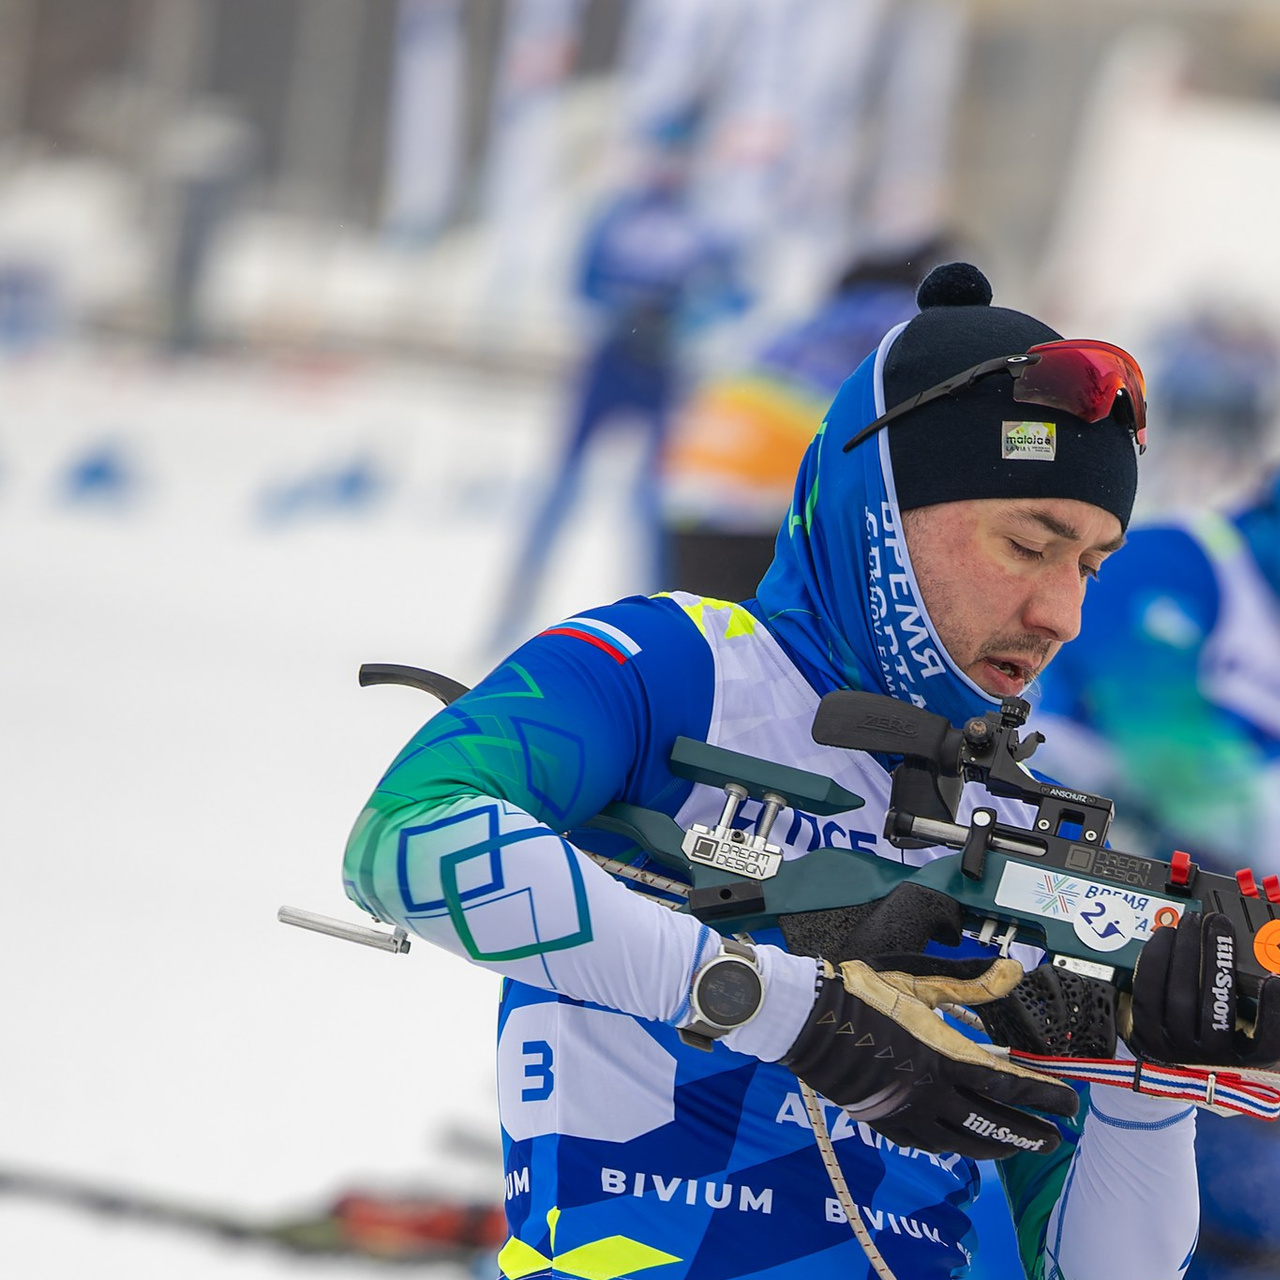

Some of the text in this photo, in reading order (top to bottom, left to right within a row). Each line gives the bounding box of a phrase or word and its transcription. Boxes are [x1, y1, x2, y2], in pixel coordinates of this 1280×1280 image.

[720, 843, 770, 865] DREAM
[1096, 852, 1152, 874] DREAM
[716, 855, 767, 877] DESIGN
[1093, 864, 1149, 886] DESIGN
[521, 1040, 554, 1103] 3
[600, 1167, 773, 1215] BIVIUM
